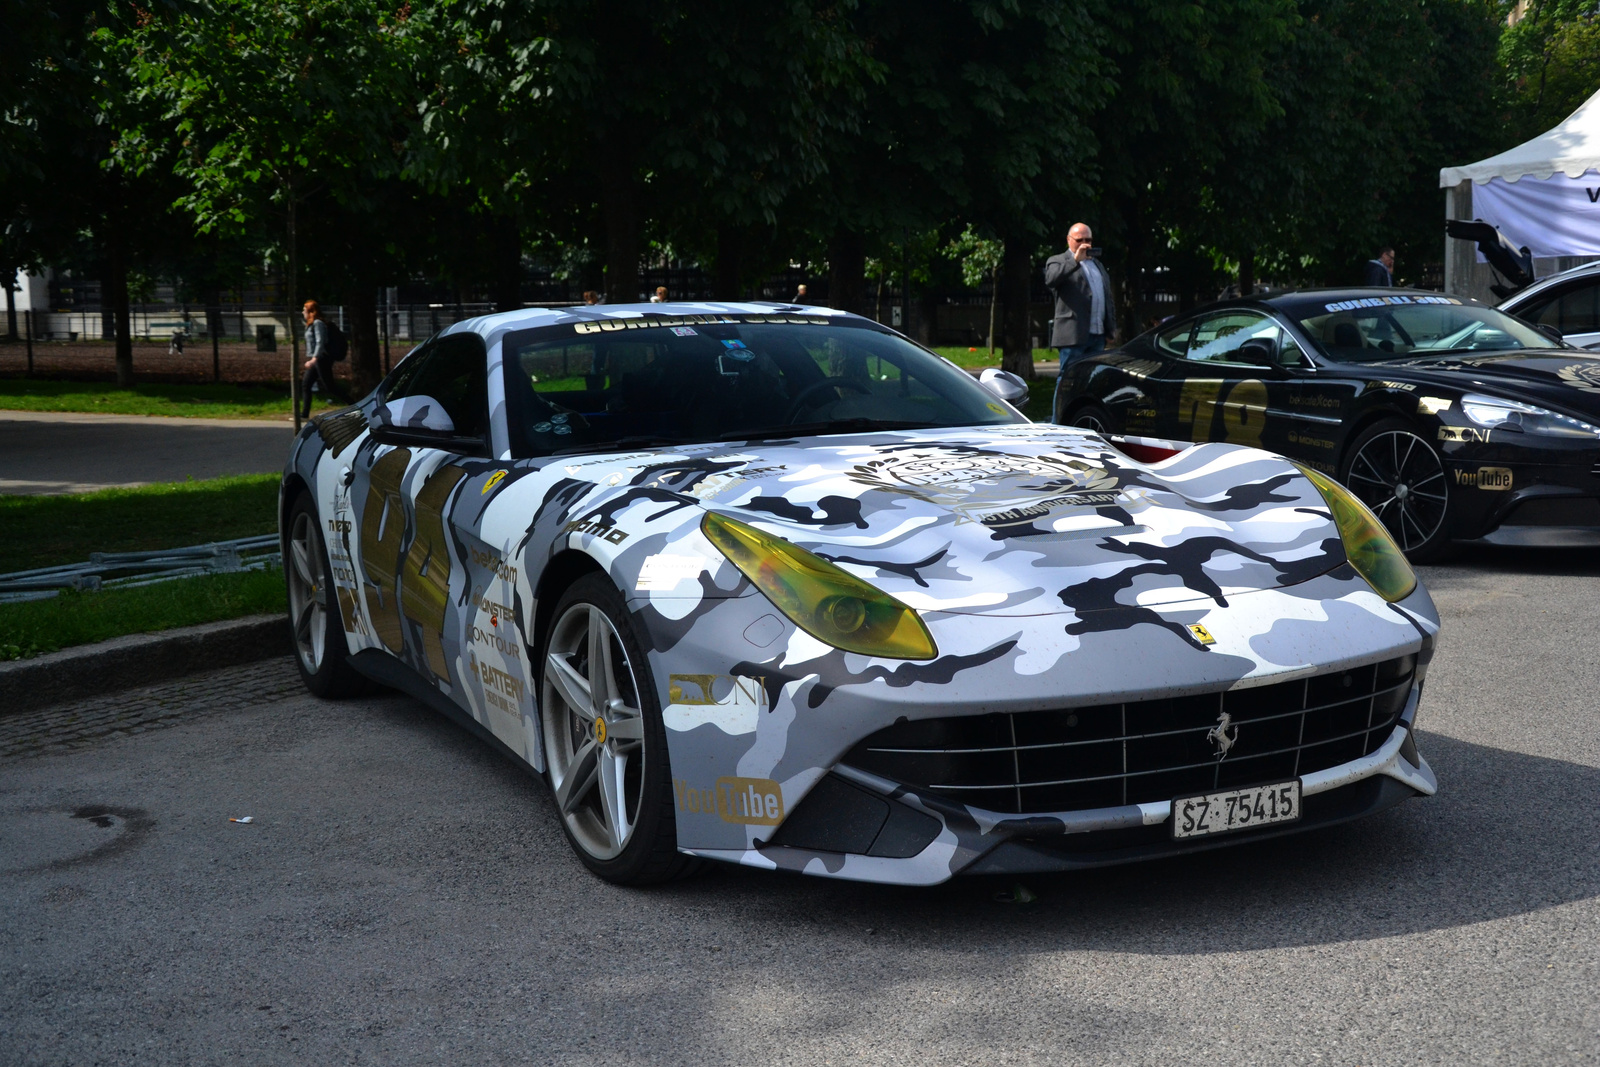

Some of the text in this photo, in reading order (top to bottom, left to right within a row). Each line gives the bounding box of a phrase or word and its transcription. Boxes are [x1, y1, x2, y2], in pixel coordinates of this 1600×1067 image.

[1324, 296, 1463, 313] GUMBALL 3000
[574, 314, 742, 335] GUMBALL
[1298, 435, 1337, 449] MONSTER
[1459, 427, 1492, 444] CNI
[1453, 467, 1512, 490] YouTube
[1019, 493, 1119, 516] ANNIVERSARY
[467, 623, 520, 660] CONTOUR
[480, 660, 524, 704] BATTERY
[708, 674, 768, 706] CNI
[674, 776, 784, 825] YouTube
[1181, 787, 1294, 832] SZ 75415
